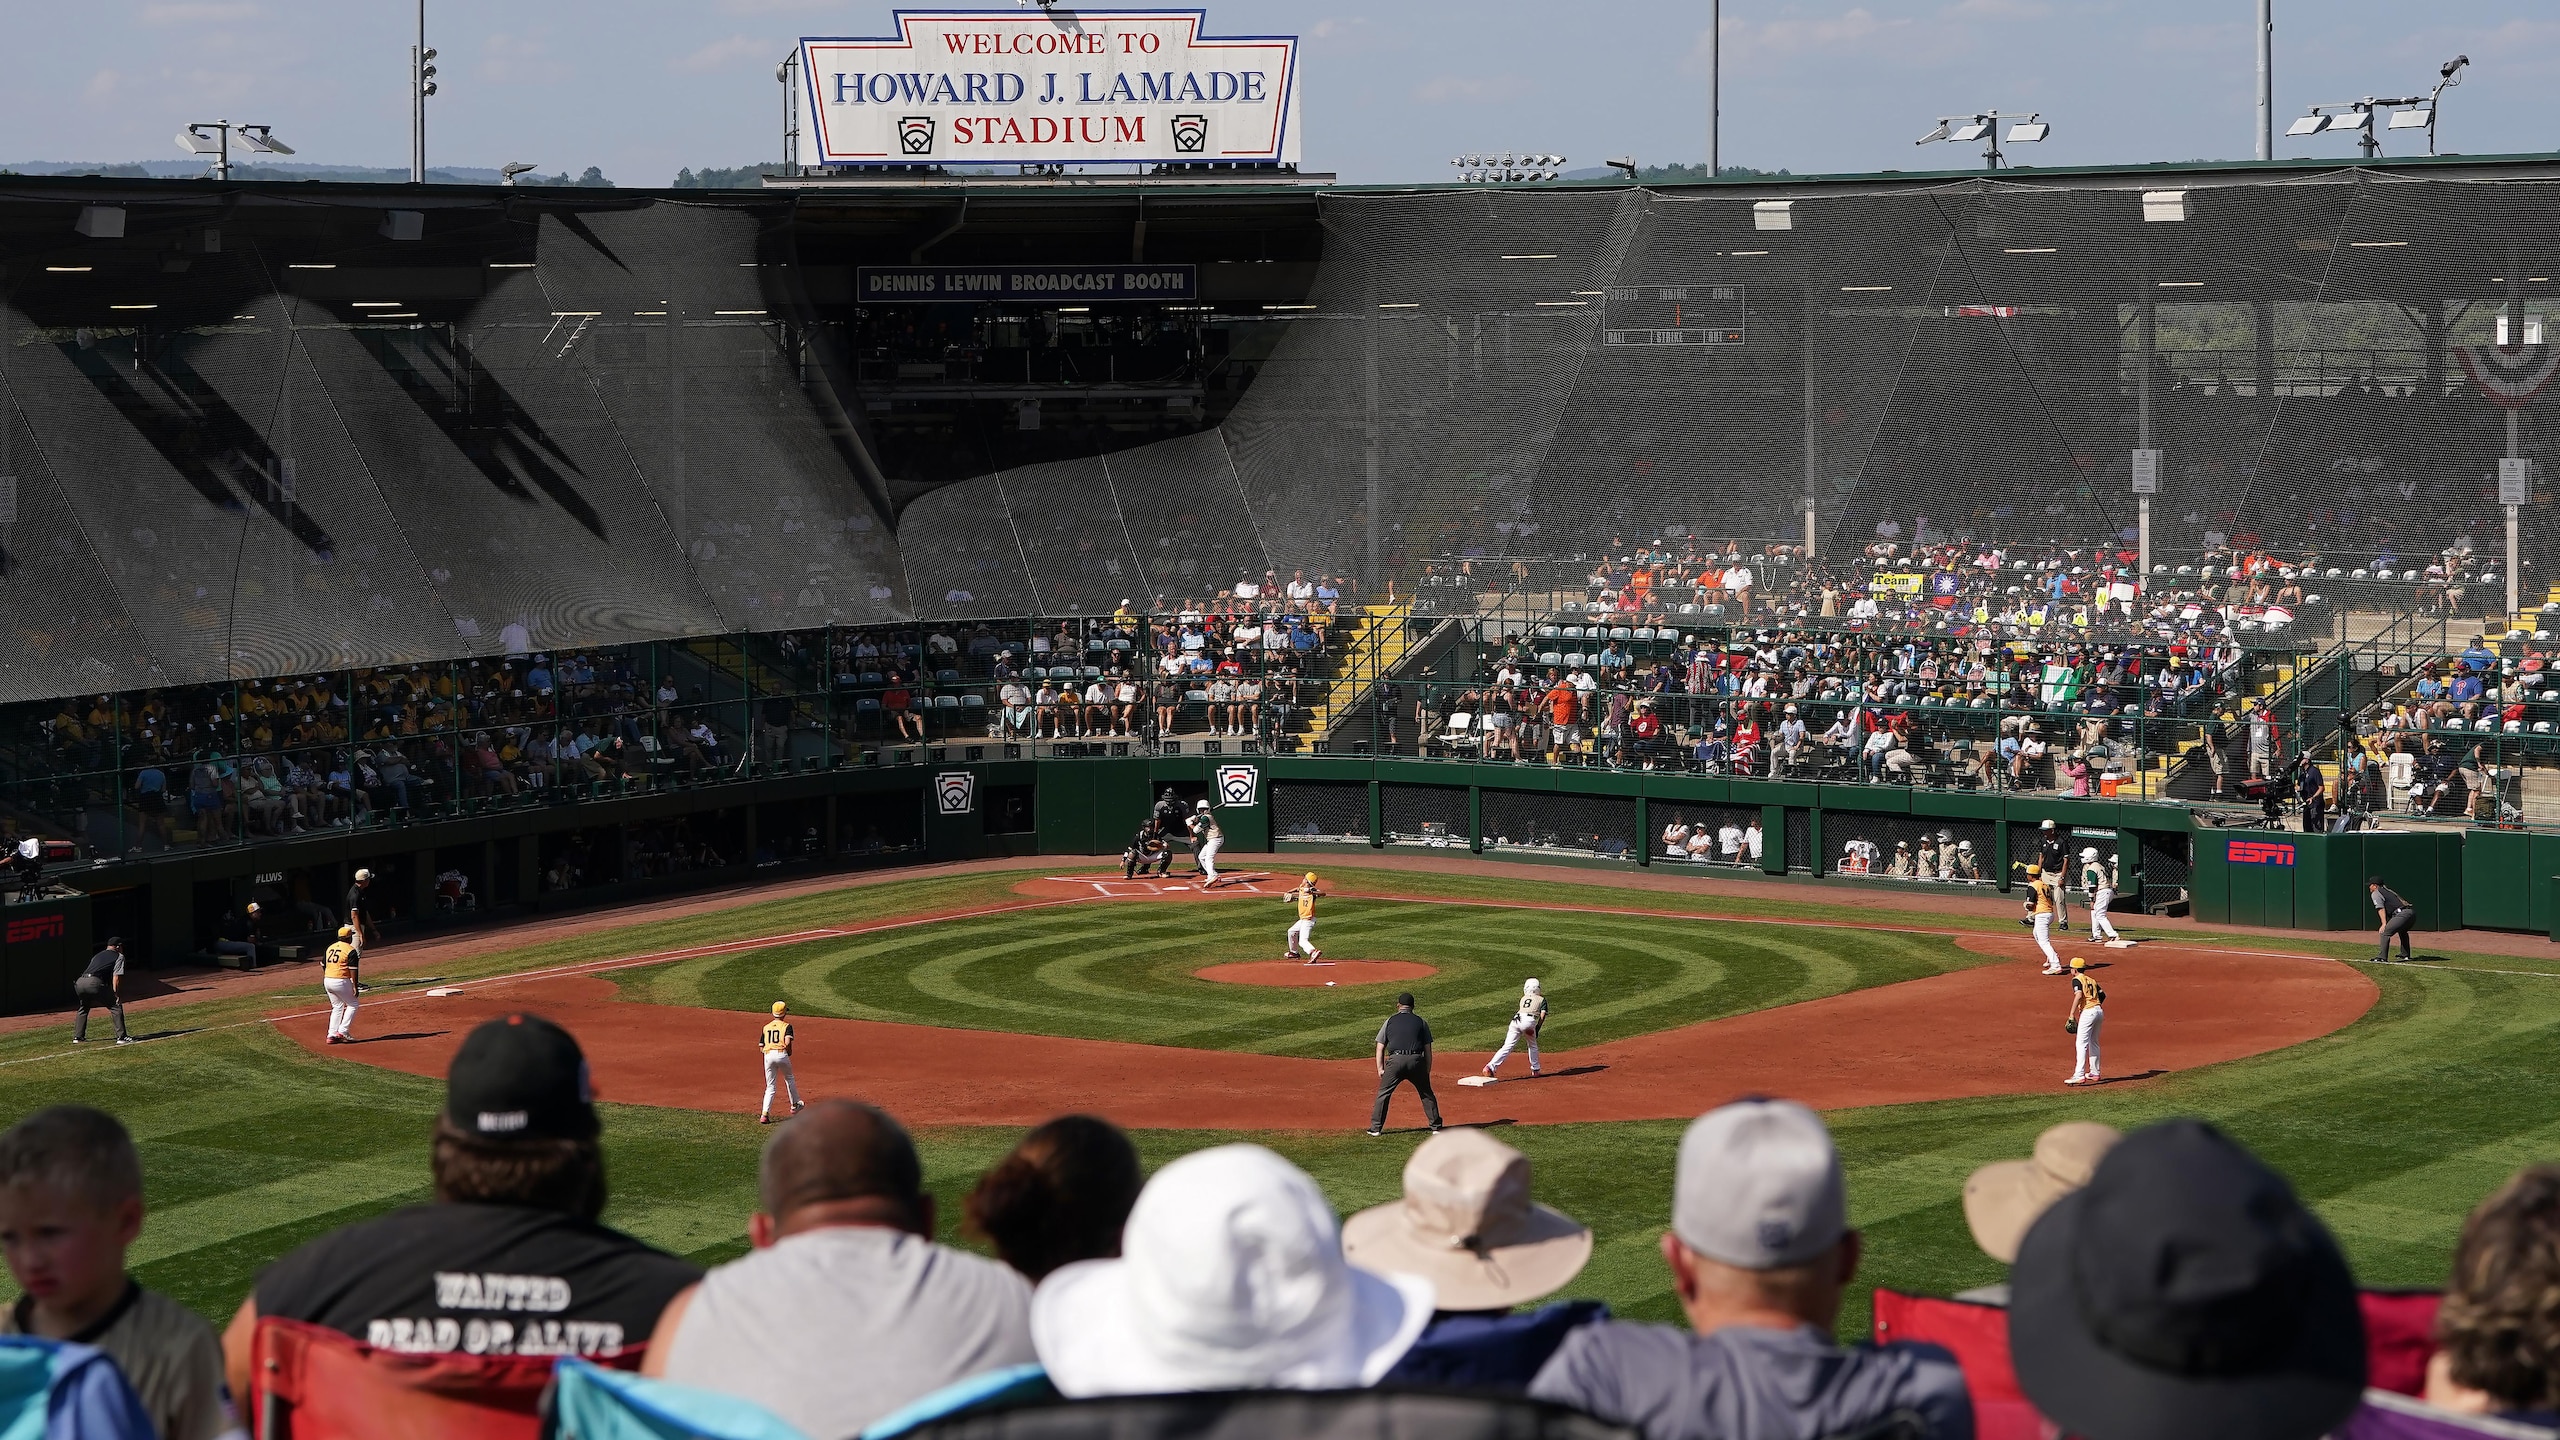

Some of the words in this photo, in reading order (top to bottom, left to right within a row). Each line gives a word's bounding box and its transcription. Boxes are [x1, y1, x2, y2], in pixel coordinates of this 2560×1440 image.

[943, 33, 1105, 54] WELCOME
[1117, 32, 1160, 53] TO
[832, 72, 1025, 105] HOWARD
[1037, 72, 1064, 104] J.
[1076, 70, 1266, 104] LAMADE
[953, 116, 1146, 144] STADIUM
[869, 275, 936, 292] DENNIS
[944, 275, 1002, 291] LEWIN
[1010, 274, 1115, 291] BROADCAST
[1123, 273, 1185, 290] BOOTH
[1874, 575, 1909, 585] Team
[2228, 841, 2295, 865] ESPN
[255, 871, 283, 884] #LLWS
[6, 914, 65, 944] ESPN
[327, 949, 341, 963] 25
[1523, 998, 1532, 1009] 8
[767, 1030, 780, 1044] 10
[434, 1271, 572, 1312] WANTED
[368, 1317, 461, 1354] DEAD
[462, 1318, 514, 1355] OR
[516, 1320, 624, 1358] ALIVE
